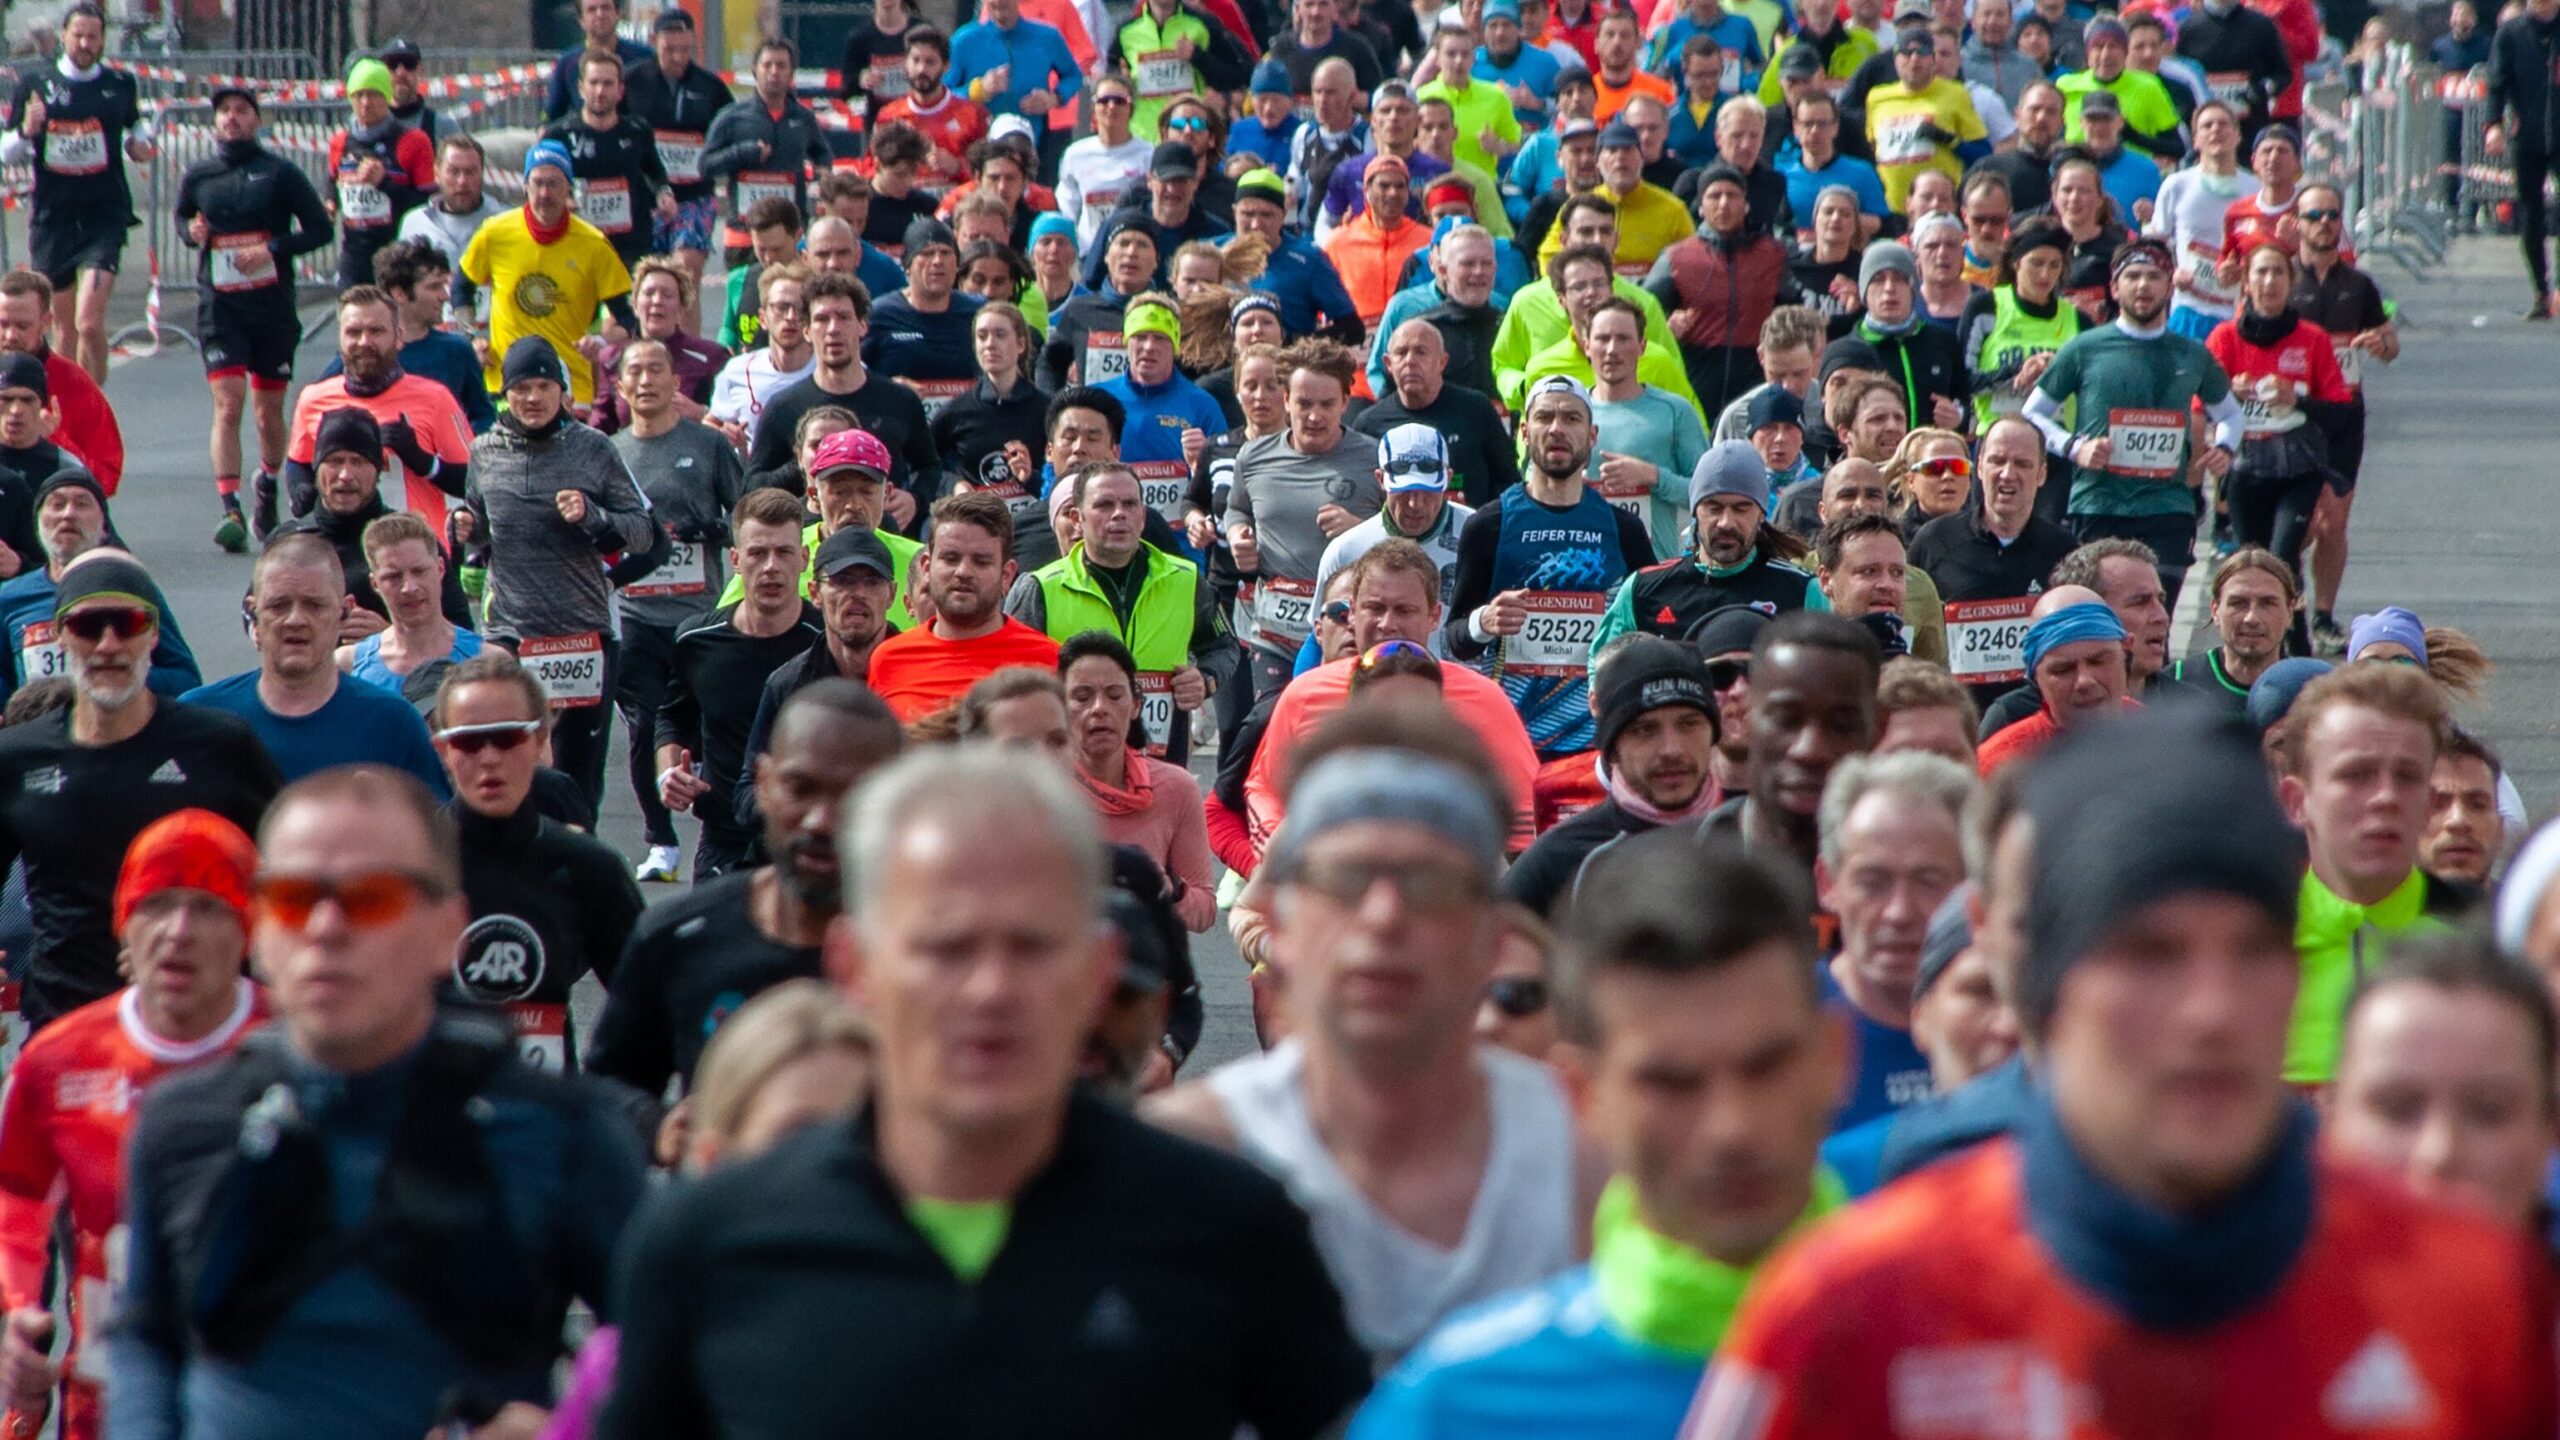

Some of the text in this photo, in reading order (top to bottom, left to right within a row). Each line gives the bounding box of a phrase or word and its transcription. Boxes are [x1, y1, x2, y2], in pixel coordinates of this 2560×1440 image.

[2126, 432, 2177, 452] 50123
[1521, 530, 1602, 544] FEIFER TEAM
[1540, 596, 1593, 609] GENERALI
[1973, 603, 2026, 617] GENERALI
[1526, 618, 1595, 643] 52522
[545, 638, 593, 652] GENERALI
[1544, 645, 1573, 655] Michal
[1984, 653, 2012, 663] Stefan
[540, 658, 595, 680] 53965
[1642, 678, 1704, 697] RUN NYC
[1146, 699, 1168, 722] 10
